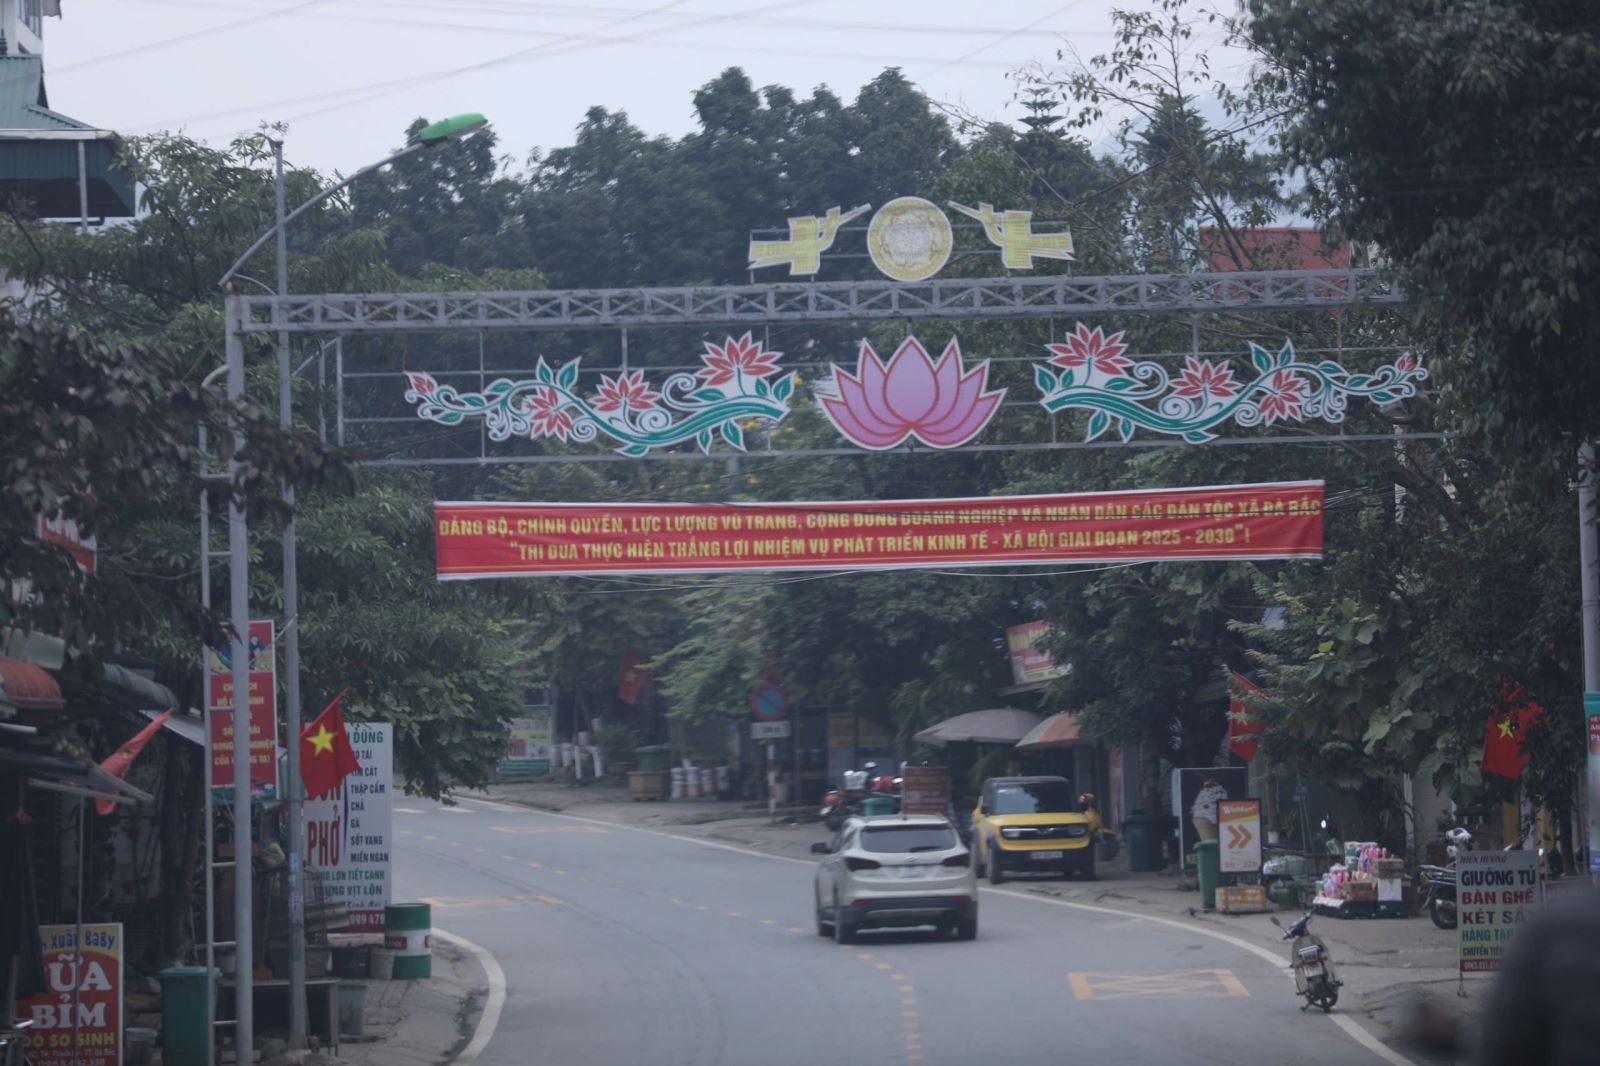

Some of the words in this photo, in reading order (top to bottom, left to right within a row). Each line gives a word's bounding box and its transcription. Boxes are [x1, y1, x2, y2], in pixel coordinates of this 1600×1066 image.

[439, 515, 482, 536] ĐẢNG
[487, 516, 513, 537] BỘ,
[517, 515, 566, 535] CHÍNH
[632, 515, 661, 534] LỰC
[666, 514, 718, 533] LƯỢNG
[721, 513, 741, 531] VŨ
[746, 514, 803, 530] TRANG,
[806, 512, 849, 531] CỘNG
[1046, 503, 1090, 521] NHÂN
[1095, 503, 1127, 520] DÂN
[1132, 502, 1162, 519] CÁC
[1203, 500, 1233, 520] TỘC
[1238, 499, 1259, 517] XÃ
[1288, 496, 1321, 516] BẮC
[548, 544, 578, 559] ĐUA
[582, 542, 622, 562] THỰC
[627, 540, 664, 560] HIỆN
[668, 536, 720, 557] THẮNG
[724, 539, 749, 558] LỢI
[753, 537, 805, 557] NHIỆM
[809, 539, 829, 556] VỤ
[834, 535, 873, 553] PHÁT
[877, 530, 924, 552] TRIỂN
[928, 534, 967, 550] KINH
[970, 530, 988, 549] TẾ
[1002, 530, 1023, 548] XÃ
[1027, 529, 1054, 551] HỘI
[1059, 532, 1090, 547] GIAI
[1095, 530, 1138, 549] ĐOẠN
[1142, 529, 1181, 545] 2025
[308, 803, 339, 867] PHỞ
[1461, 867, 1513, 887] GIƯỜNG
[1519, 864, 1535, 885] TỦ
[1462, 888, 1496, 904] BÀN
[1503, 886, 1535, 904] GHẾ
[1463, 908, 1495, 924] KÉT
[45, 953, 112, 993] ỮA
[31, 994, 107, 1030] BỈM
